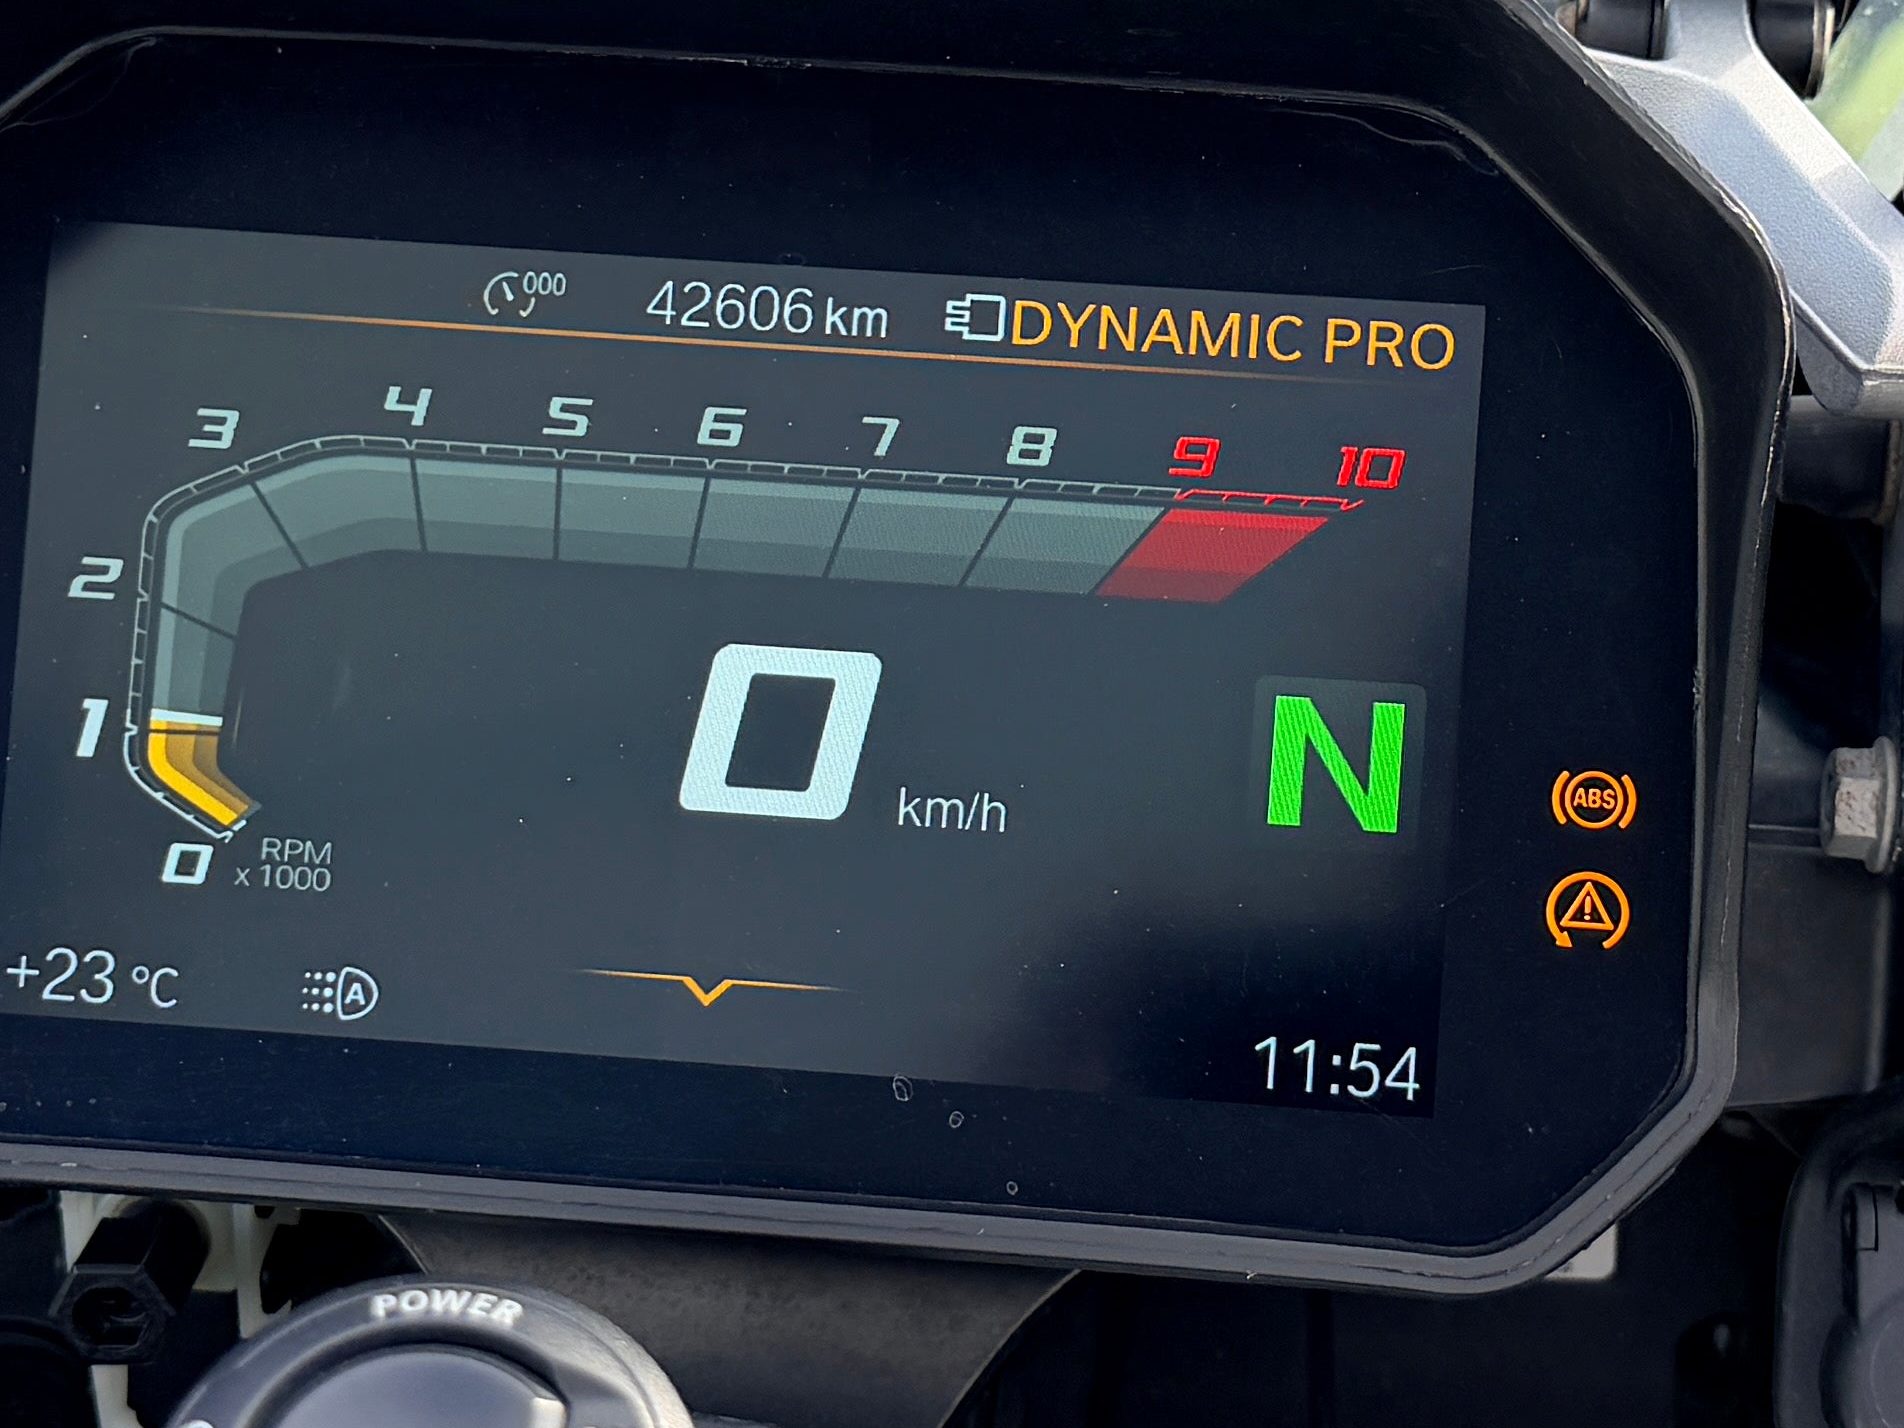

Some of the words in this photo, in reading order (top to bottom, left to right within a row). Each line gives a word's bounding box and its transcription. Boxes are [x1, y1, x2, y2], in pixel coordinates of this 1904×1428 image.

[522, 270, 567, 299] 000
[645, 280, 814, 336] 42606
[824, 296, 889, 339] km
[1011, 299, 1303, 363] DYNAMIC
[1324, 318, 1456, 370] PRO
[188, 407, 241, 450] 3
[383, 385, 434, 427] 4
[542, 396, 595, 438] 5
[696, 406, 747, 448] 6
[861, 416, 900, 458] 7
[1006, 426, 1058, 468] 8
[1168, 436, 1221, 478] 9
[1336, 446, 1406, 490] 10
[67, 556, 125, 601] 2
[76, 698, 110, 759] 1
[678, 642, 883, 822] 0
[897, 785, 1007, 834] km/h
[1265, 694, 1406, 834] N
[1572, 787, 1616, 810] ABS
[161, 842, 214, 886] 0
[259, 863, 332, 893] 1000
[260, 836, 333, 866] RPM
[6, 946, 116, 1005] +23
[131, 965, 180, 1009] °C
[1254, 1035, 1421, 1102] 11:54
[371, 1289, 524, 1326] POWER
